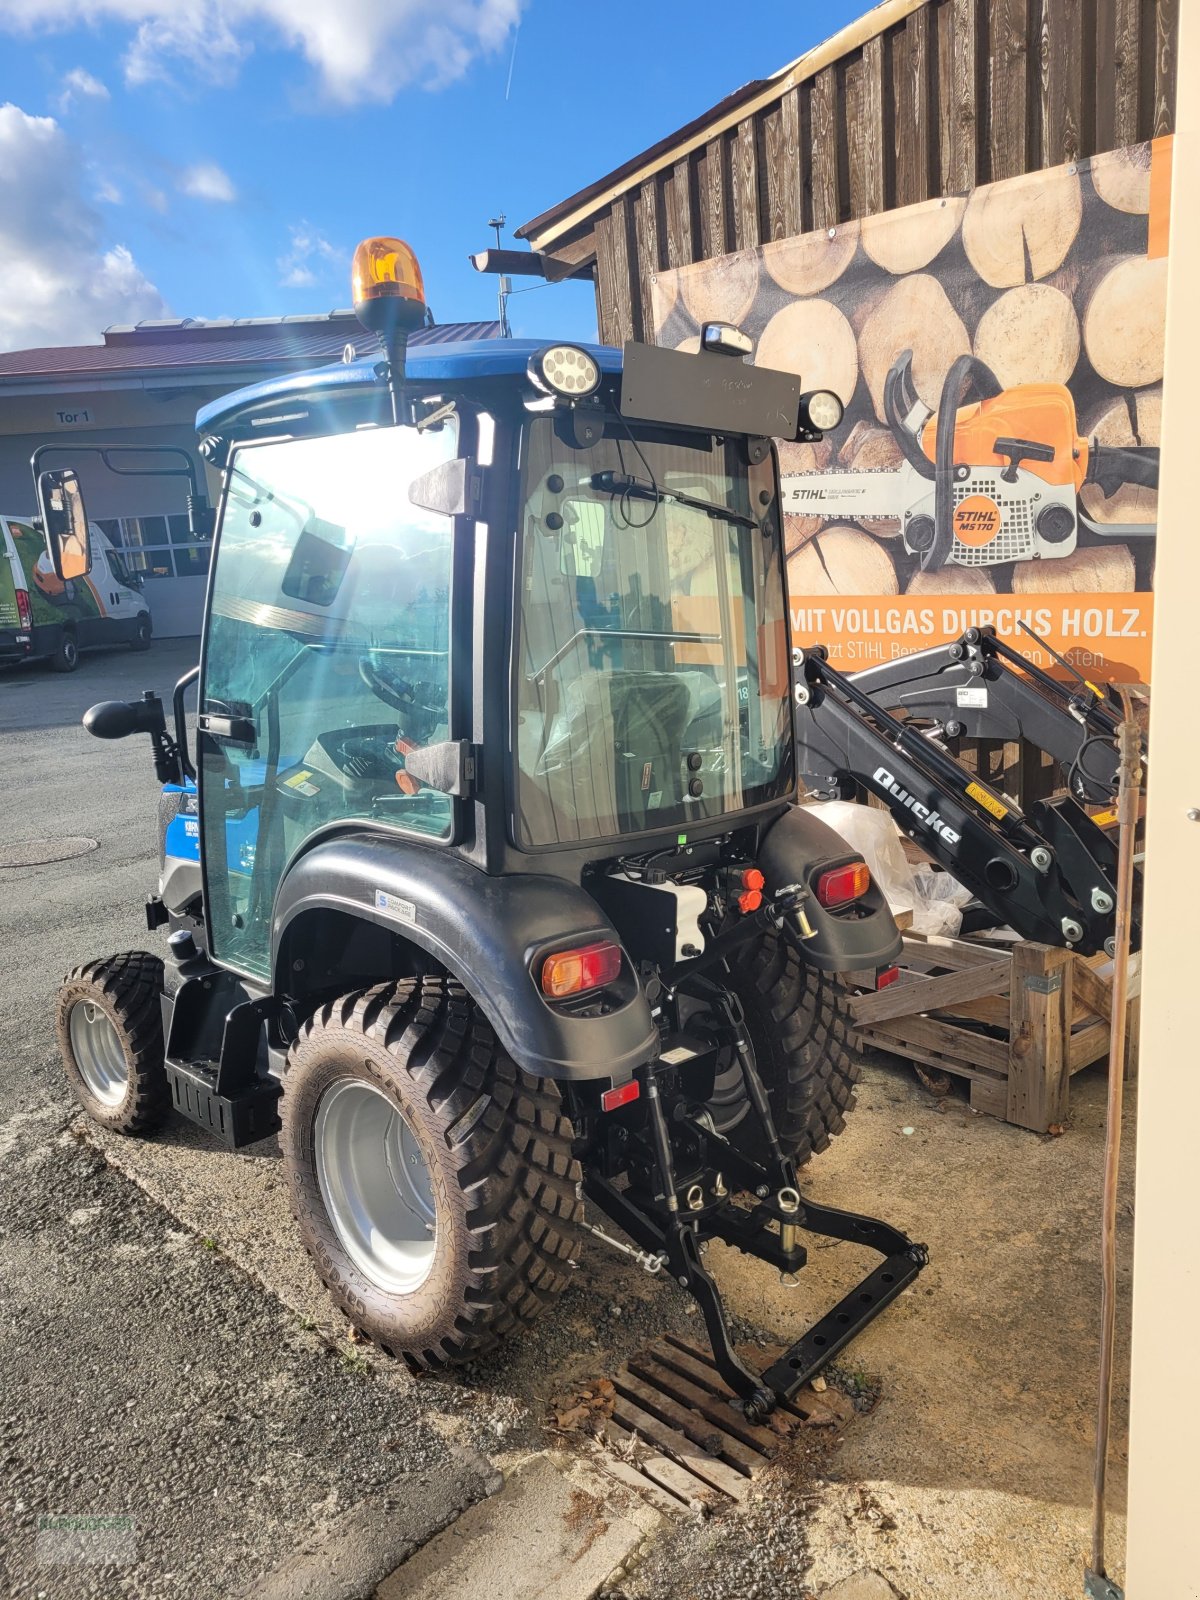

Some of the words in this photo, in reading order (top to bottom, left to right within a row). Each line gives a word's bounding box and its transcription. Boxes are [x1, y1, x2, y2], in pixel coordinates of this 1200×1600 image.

[56, 411, 79, 423] Tor
[82, 410, 89, 422] 1
[792, 489, 826, 499] STIHL
[955, 511, 996, 521] STIHL
[790, 608, 826, 632] MIT
[831, 609, 935, 634] VOLLGAS
[943, 609, 1052, 636] DURCHS
[1061, 608, 1147, 637] HOLZ.
[847, 641, 886, 659] STIHL
[873, 767, 961, 844] Quicke
[315, 1239, 366, 1319] Garden
